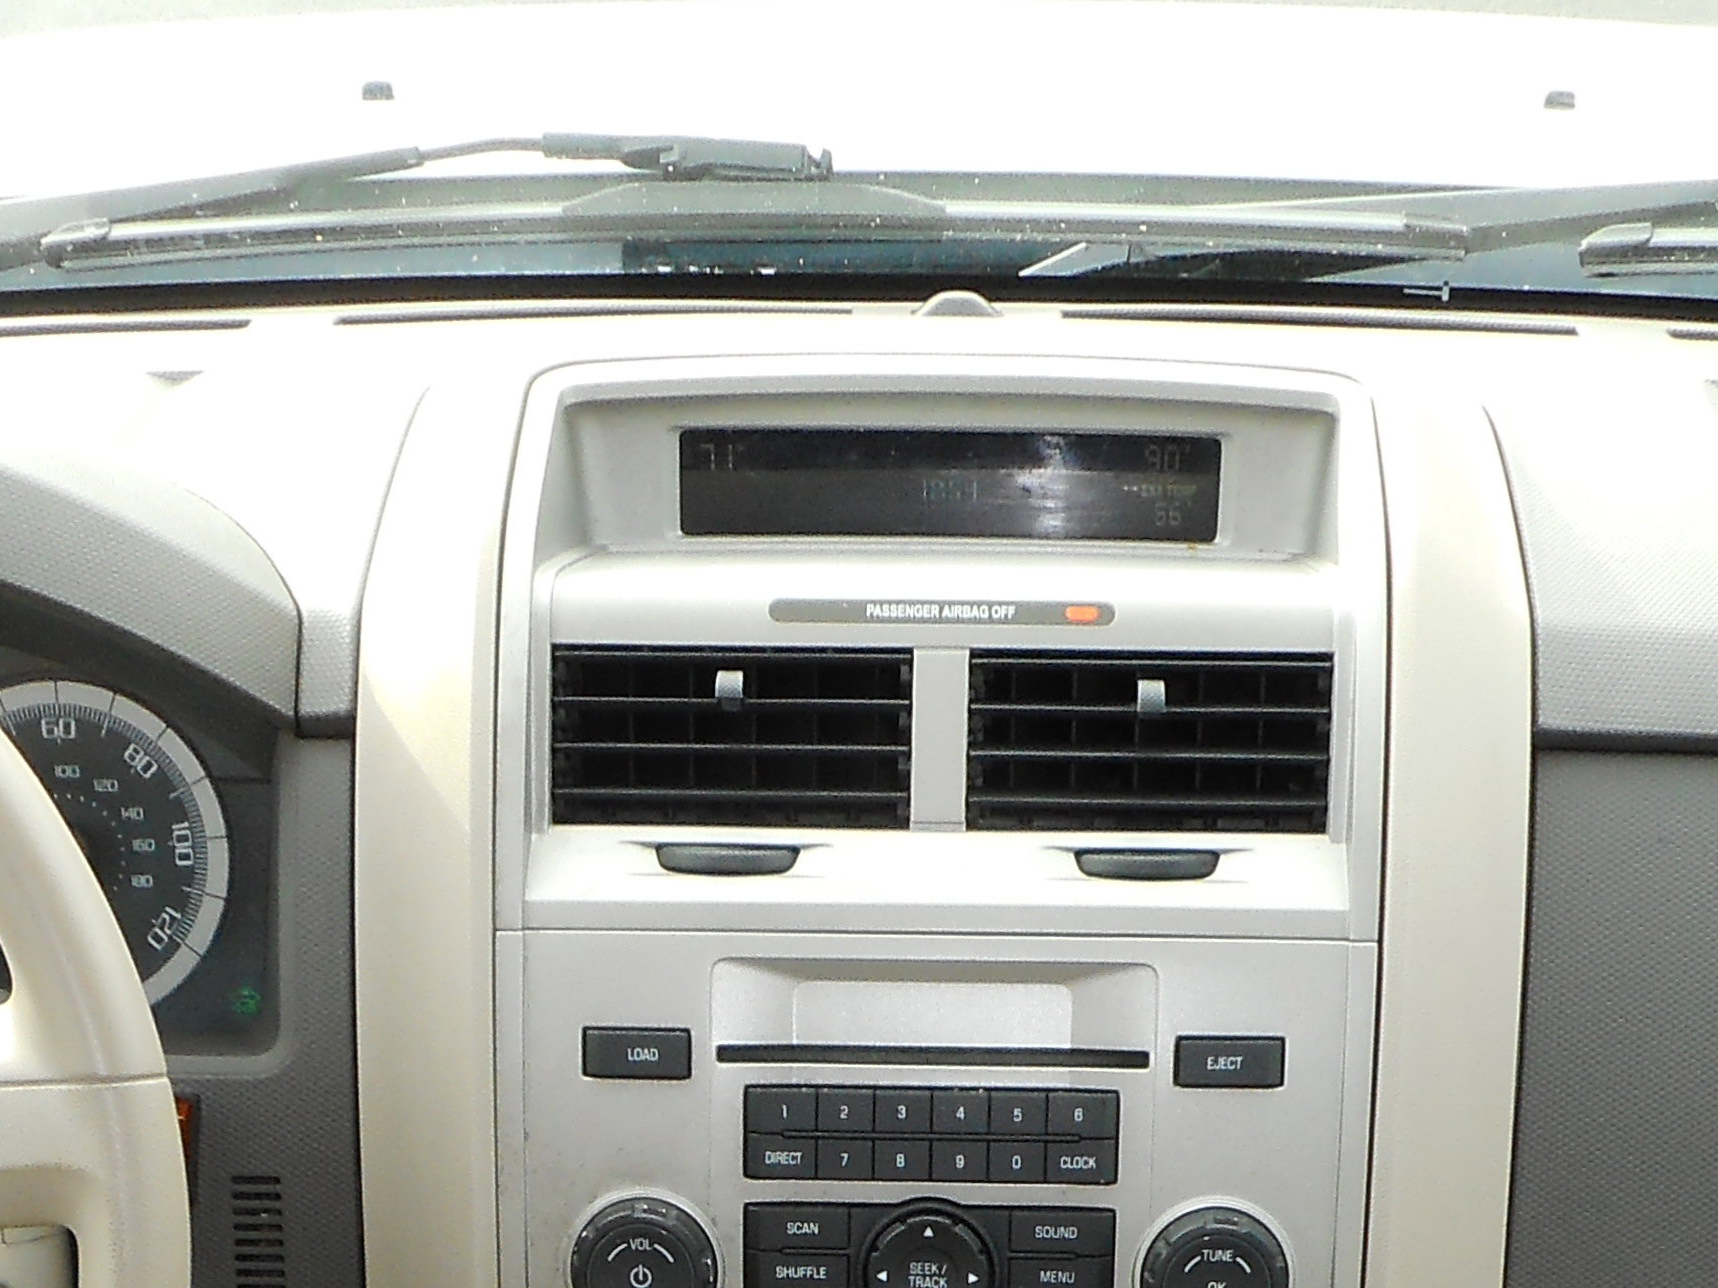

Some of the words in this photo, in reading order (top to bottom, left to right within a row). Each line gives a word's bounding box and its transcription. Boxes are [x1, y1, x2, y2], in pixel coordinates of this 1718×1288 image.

[866, 603, 940, 618] PASSENGER
[941, 604, 989, 619] AIRBAG
[991, 605, 1016, 619] OFF
[41, 718, 76, 739] 60
[124, 743, 158, 779] 80
[55, 765, 80, 778] 100
[93, 779, 118, 792] 120
[121, 807, 145, 820] 140
[132, 839, 155, 851] 160
[171, 822, 194, 866] 100
[131, 875, 154, 887] 180
[147, 906, 183, 951] 120
[627, 1047, 659, 1062] LOAD
[1206, 1056, 1243, 1070] EJECT
[839, 1105, 849, 1119] 2
[897, 1104, 906, 1119] 3
[956, 1106, 965, 1120] 4
[1013, 1107, 1023, 1122] 5
[1074, 1107, 1084, 1122] 6
[764, 1150, 803, 1165] DIRECT
[840, 1152, 849, 1167] 7
[896, 1153, 905, 1168] 8
[955, 1154, 965, 1169] 9
[1011, 1155, 1022, 1170] 0
[1060, 1156, 1097, 1169] CLOCK
[786, 1221, 819, 1235] SCAN
[1034, 1225, 1078, 1239] SOUND
[629, 1237, 652, 1251] VOL
[1202, 1249, 1233, 1262] TUNE
[775, 1265, 827, 1279] SHUFFLE
[1039, 1270, 1075, 1284] MENU
[908, 1275, 948, 1288] TRACK
